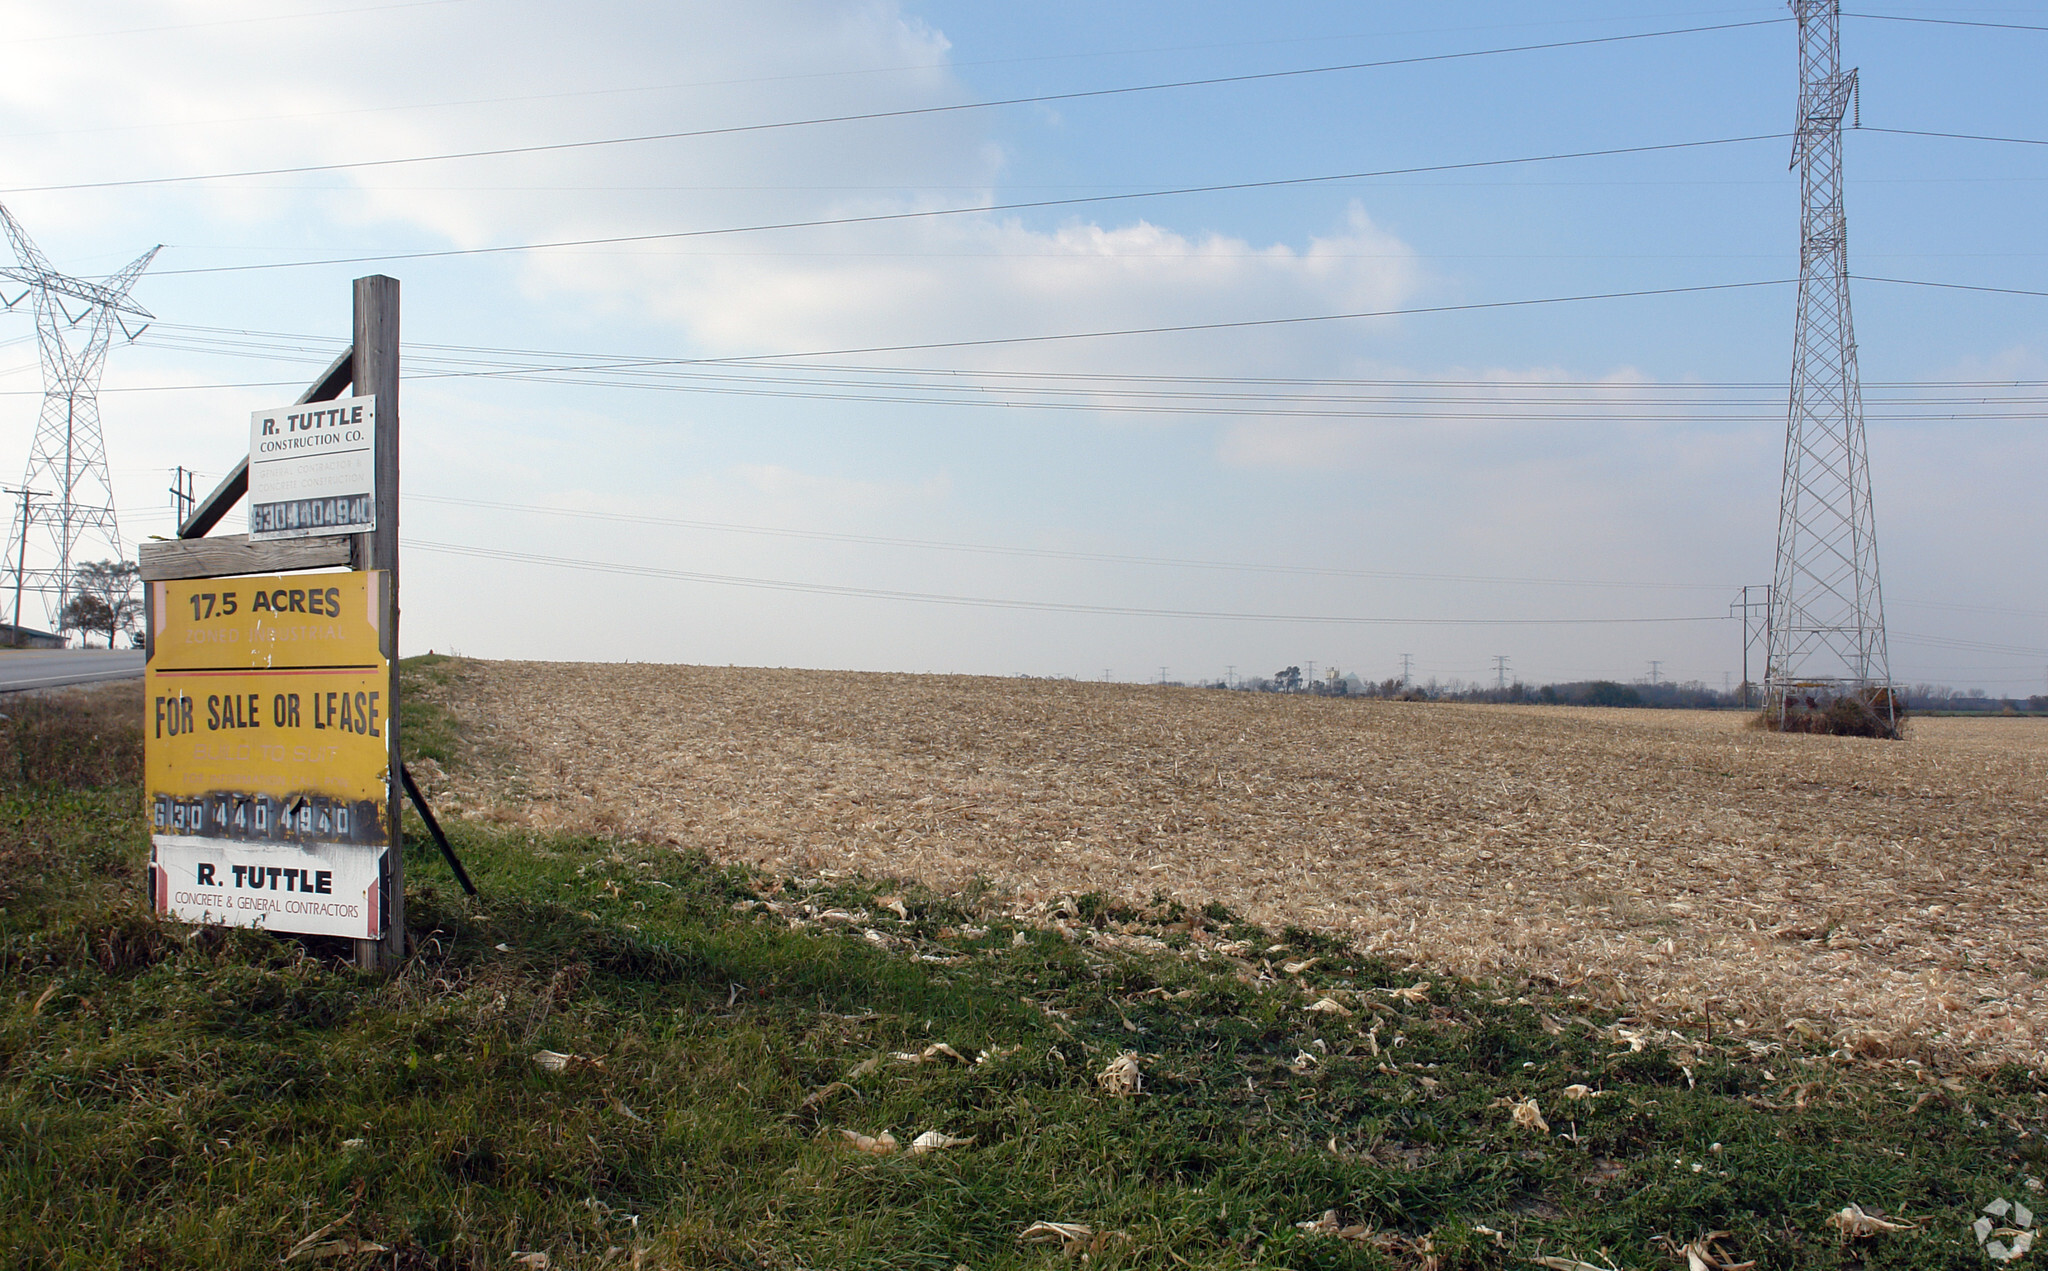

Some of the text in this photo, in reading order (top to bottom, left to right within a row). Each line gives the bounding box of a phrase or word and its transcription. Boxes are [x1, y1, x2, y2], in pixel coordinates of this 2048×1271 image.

[262, 406, 363, 436] R. TUTTLE
[260, 430, 365, 453] CONSTRUCTION CO.
[190, 587, 341, 621] 17.5 ACRES
[185, 624, 346, 644] ZONED INDUSTRIAL
[155, 696, 194, 739] FOR
[207, 693, 260, 731] SALE
[273, 693, 300, 728] OR
[193, 743, 339, 763] BUILD TO SUIT
[154, 801, 202, 830] 630
[216, 802, 268, 830] 440
[197, 862, 332, 895] R. TUTTLE
[175, 891, 359, 918] CONCRETE & GENERAL CONTRACTORS
